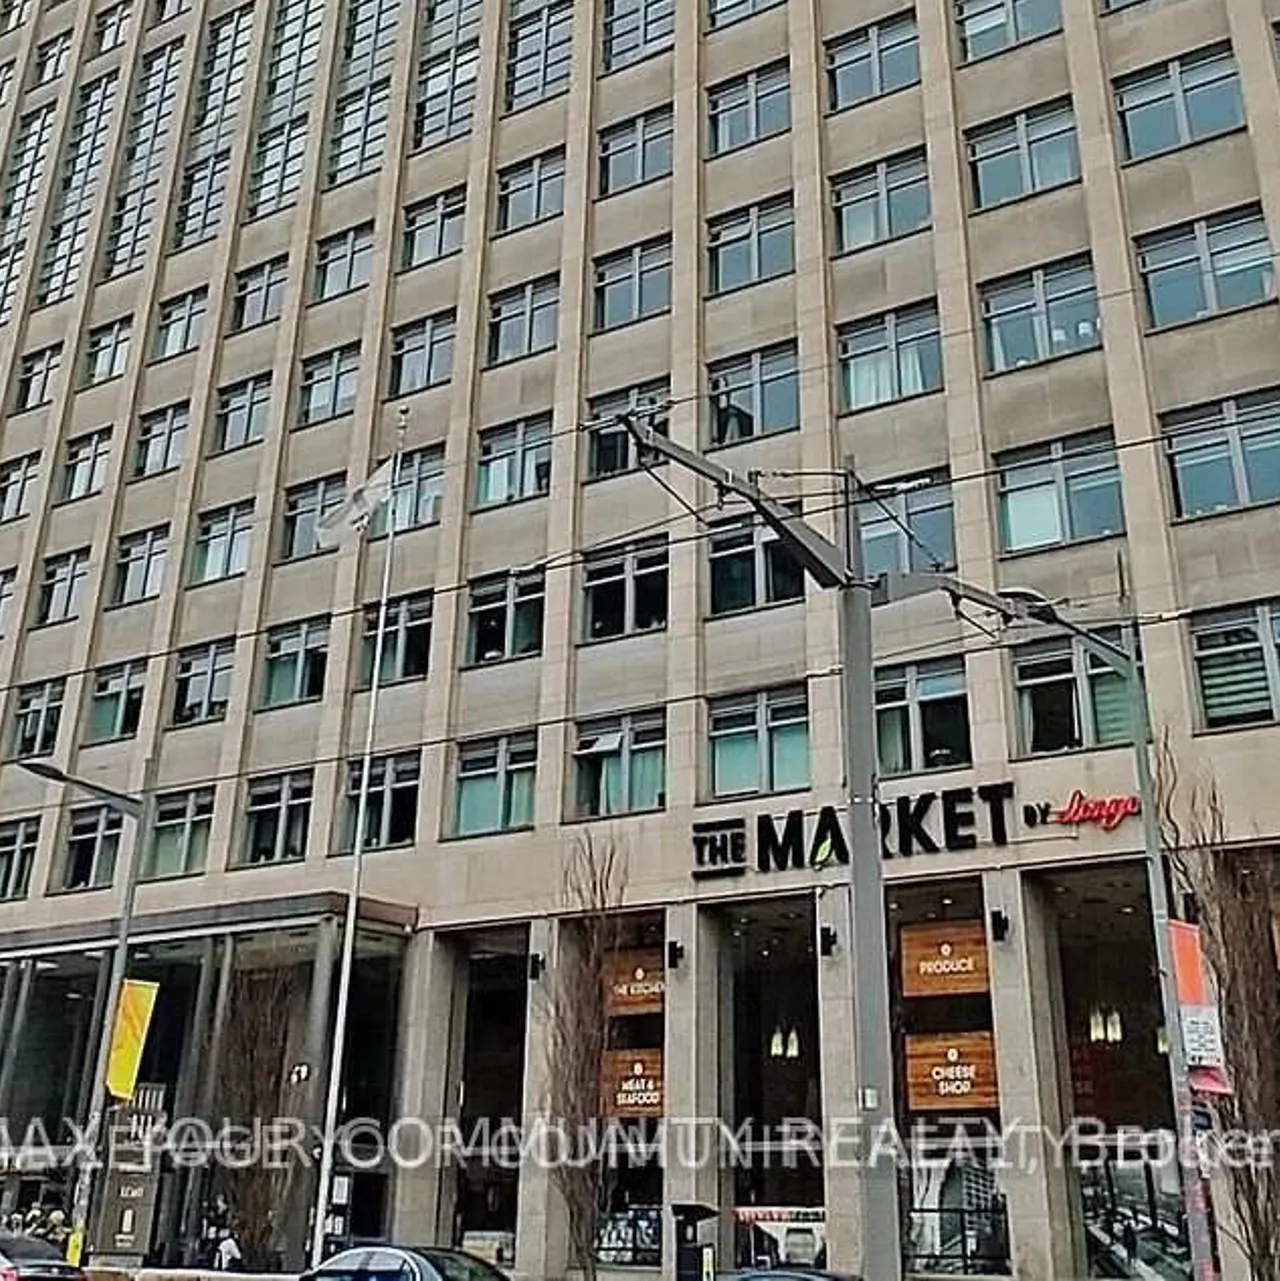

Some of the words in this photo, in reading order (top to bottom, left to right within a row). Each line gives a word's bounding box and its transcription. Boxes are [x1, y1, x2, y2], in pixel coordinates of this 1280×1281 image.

[692, 832, 746, 866] THE
[1023, 802, 1052, 828] BY
[919, 957, 975, 975] PRODUCE
[931, 1065, 977, 1081] CHEESE
